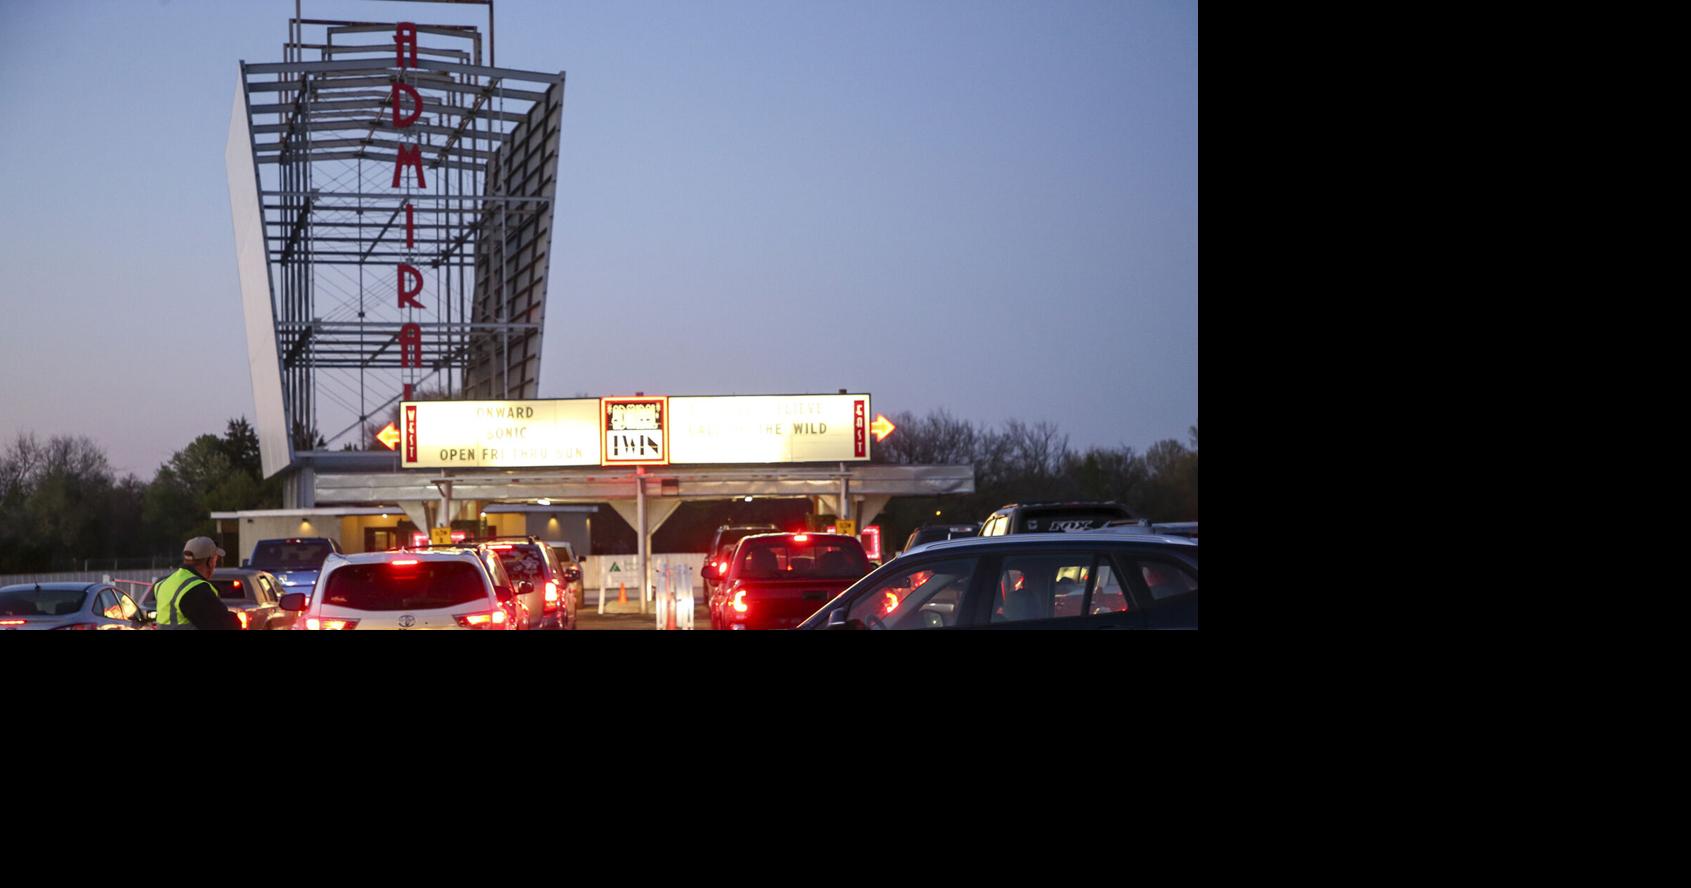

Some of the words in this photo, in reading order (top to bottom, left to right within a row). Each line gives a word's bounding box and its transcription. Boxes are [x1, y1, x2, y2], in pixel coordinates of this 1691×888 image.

[476, 406, 534, 418] ONWARD
[407, 409, 416, 458] WEST
[487, 427, 527, 440] SONIC
[793, 422, 828, 435] WILD
[856, 404, 864, 453] EAST
[439, 448, 476, 461] OPEN
[482, 448, 504, 460] FRI
[555, 447, 584, 459] SUN
